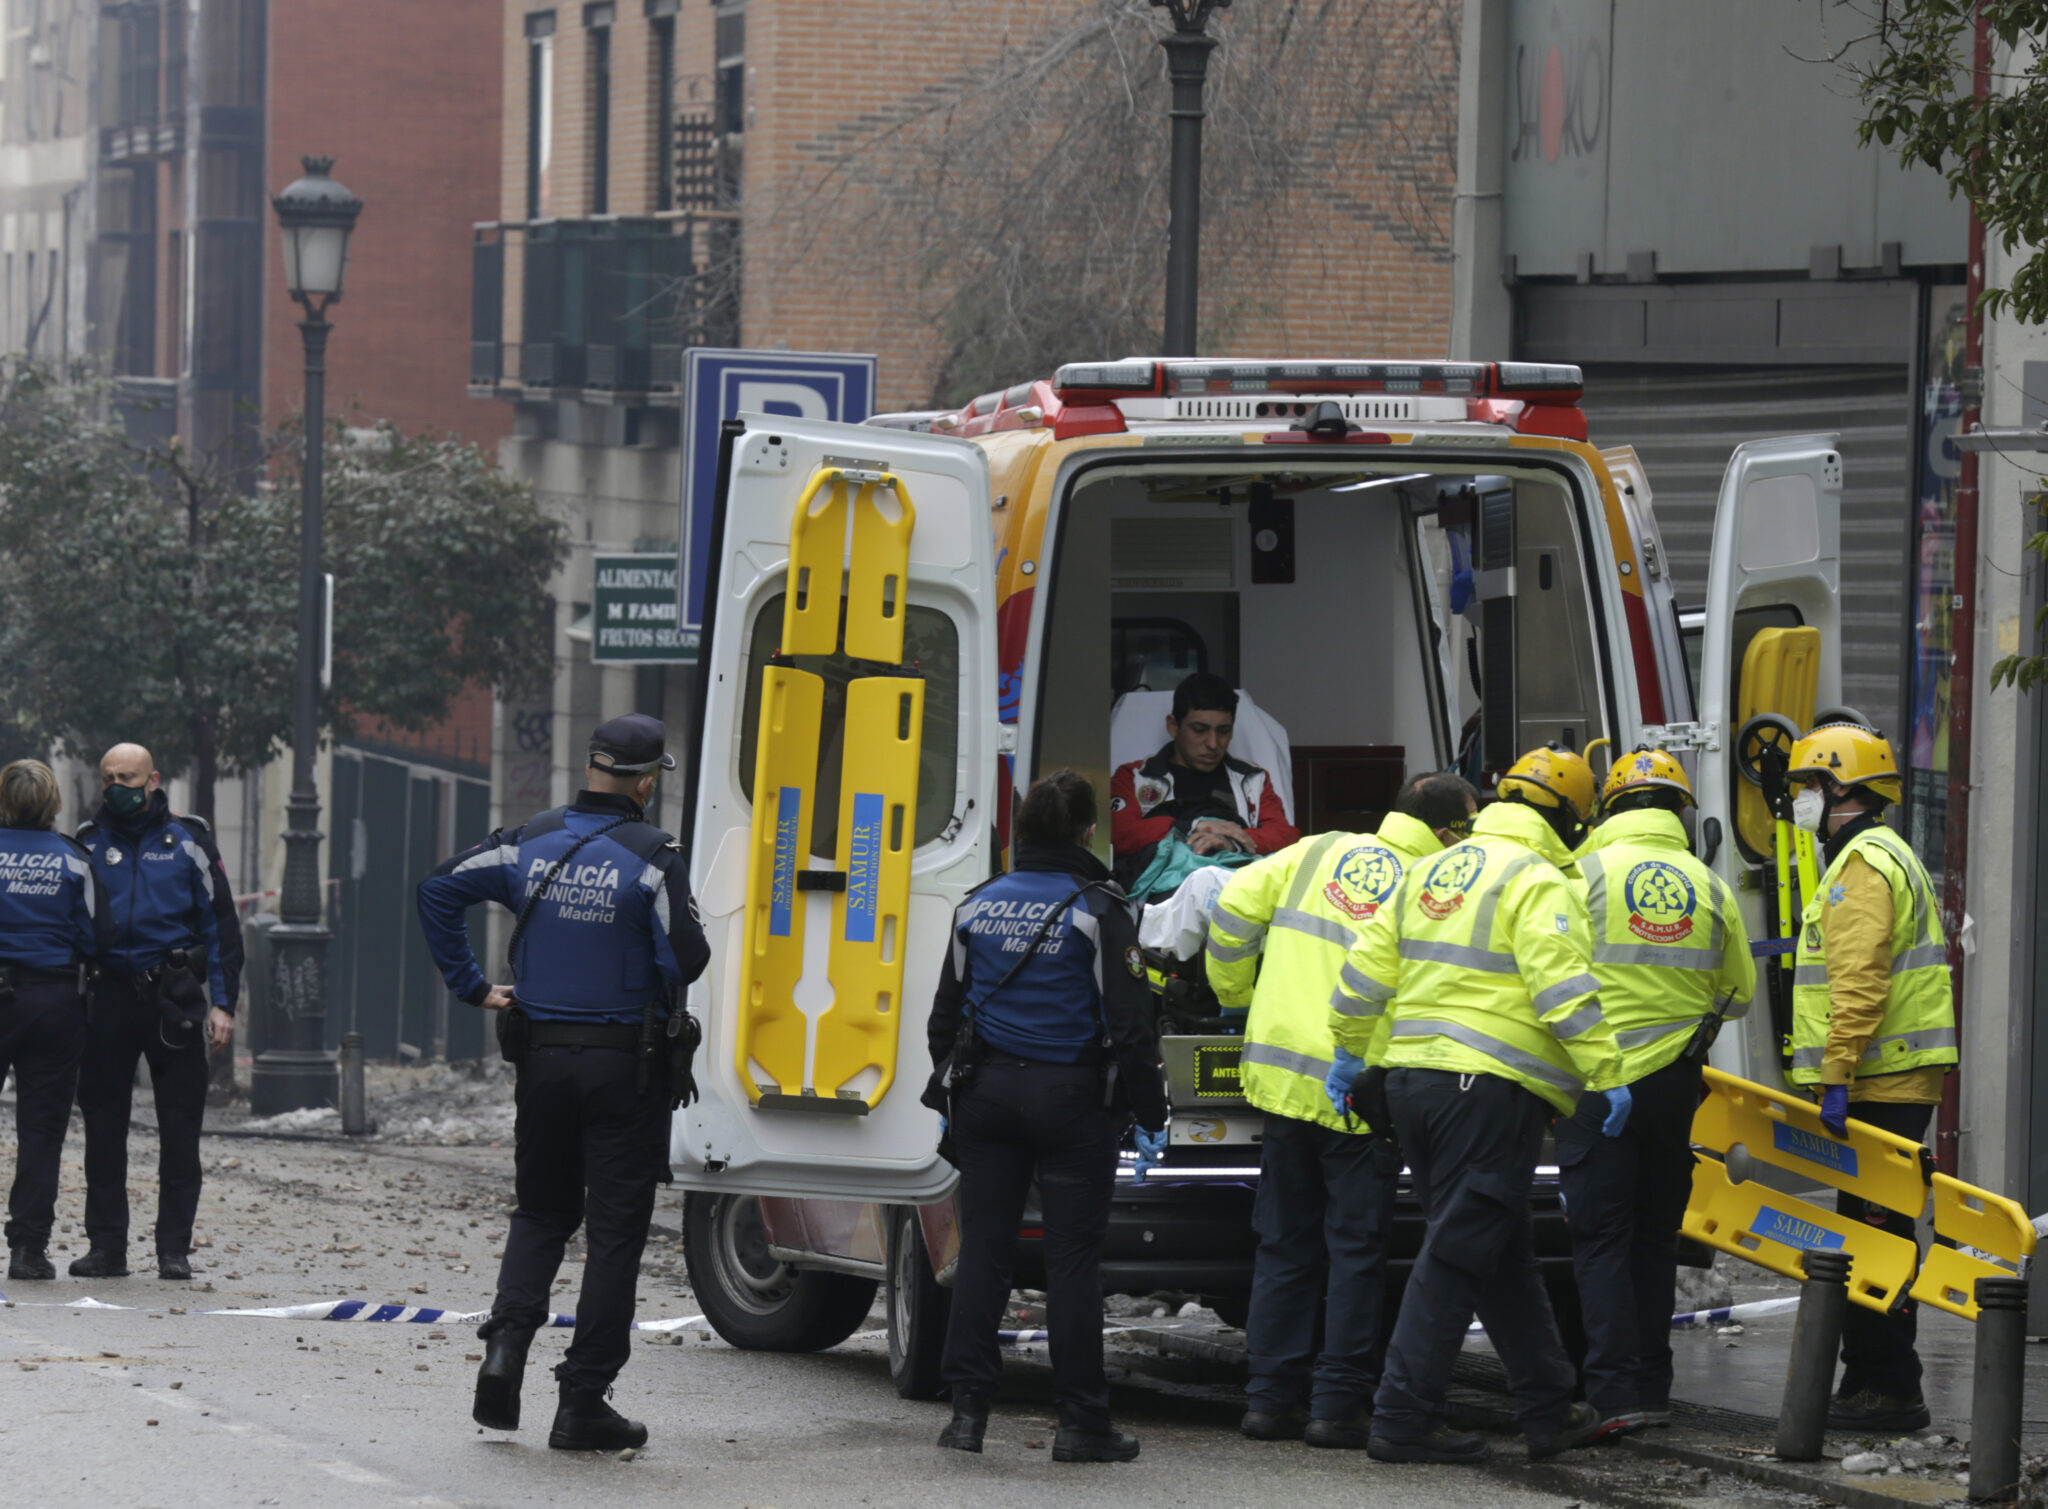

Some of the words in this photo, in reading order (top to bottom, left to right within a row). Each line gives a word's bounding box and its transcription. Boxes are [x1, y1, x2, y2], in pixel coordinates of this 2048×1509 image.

[527, 858, 619, 889] POLICÍA
[773, 820, 791, 903] SAMUR
[849, 826, 871, 909] SAMUR
[6, 880, 61, 895] Madrid
[525, 880, 616, 908] MUNICIPAL
[558, 905, 616, 923] Madrid
[1791, 1128, 1840, 1160] SAMUR
[1773, 1214, 1826, 1246] SAMUR
